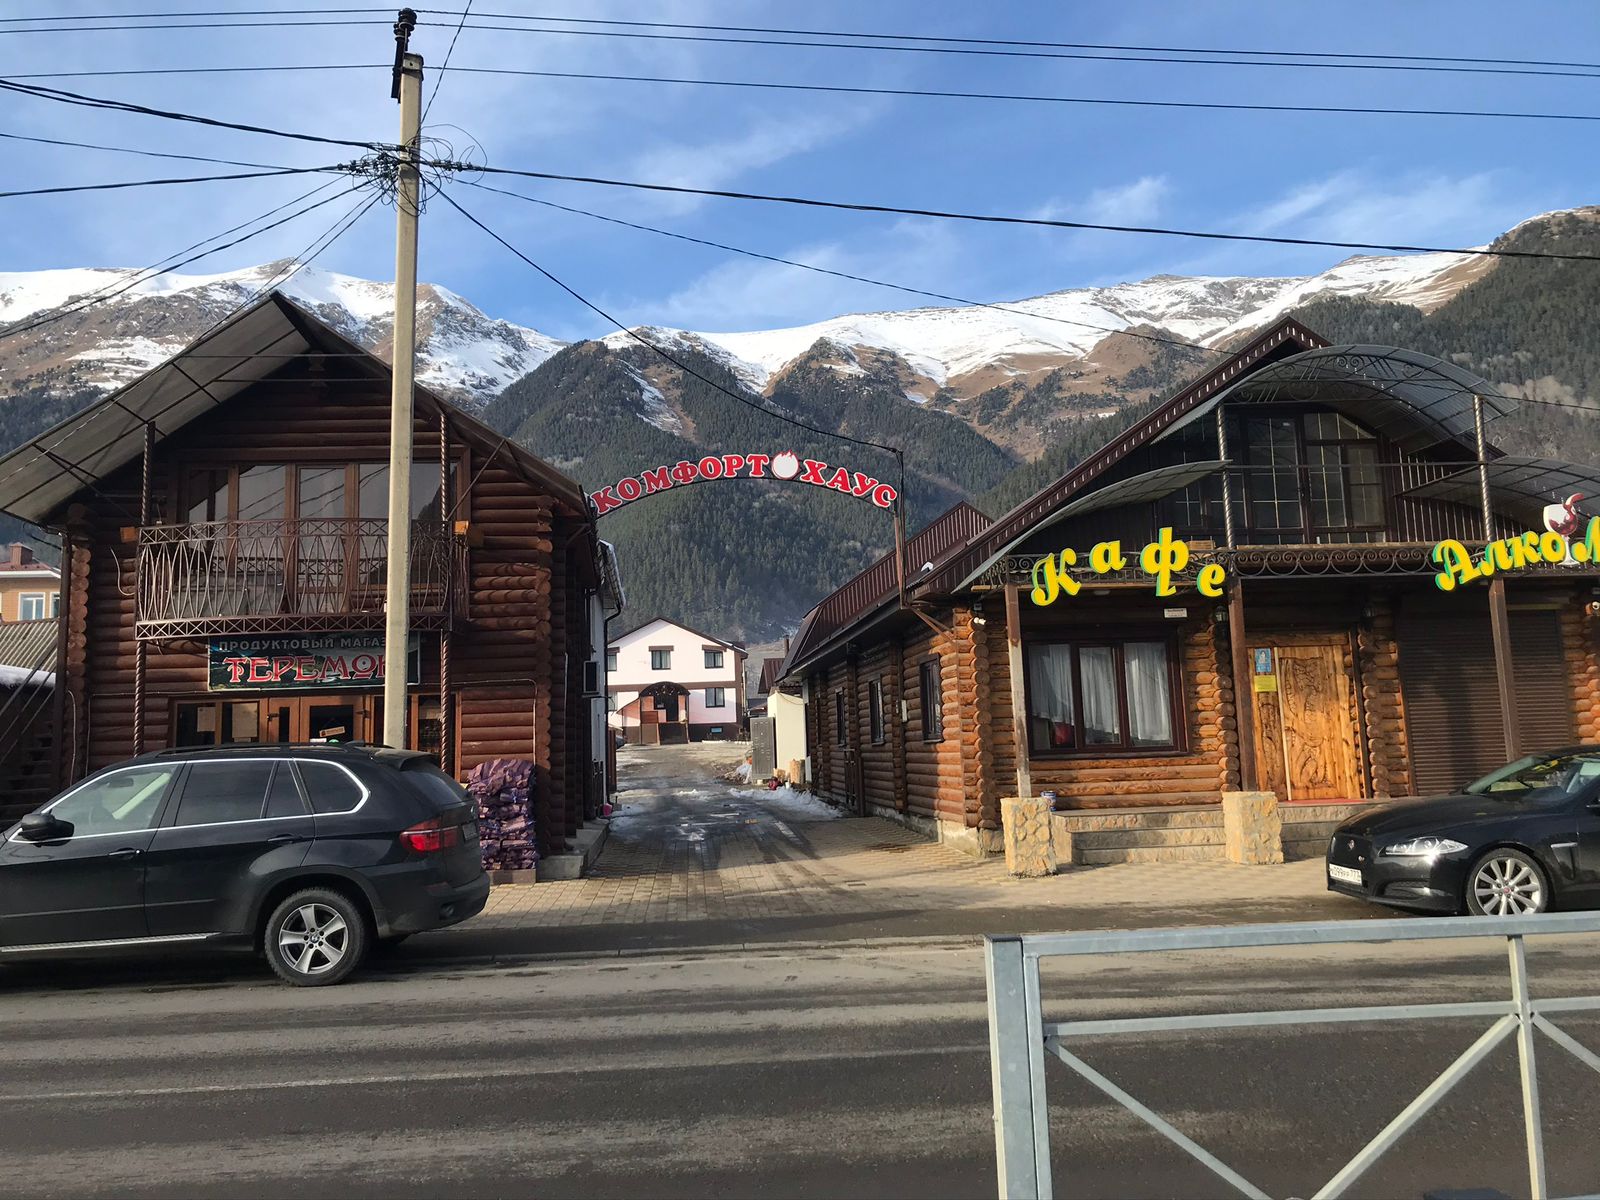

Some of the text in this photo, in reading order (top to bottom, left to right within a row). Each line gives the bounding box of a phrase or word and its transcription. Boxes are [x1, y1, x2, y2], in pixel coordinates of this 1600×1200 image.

[590, 454, 897, 515] КОМФОРТ ХАУС
[1030, 526, 1226, 607] Кафе
[219, 638, 334, 651] ПРОДУКТОВЫЙ
